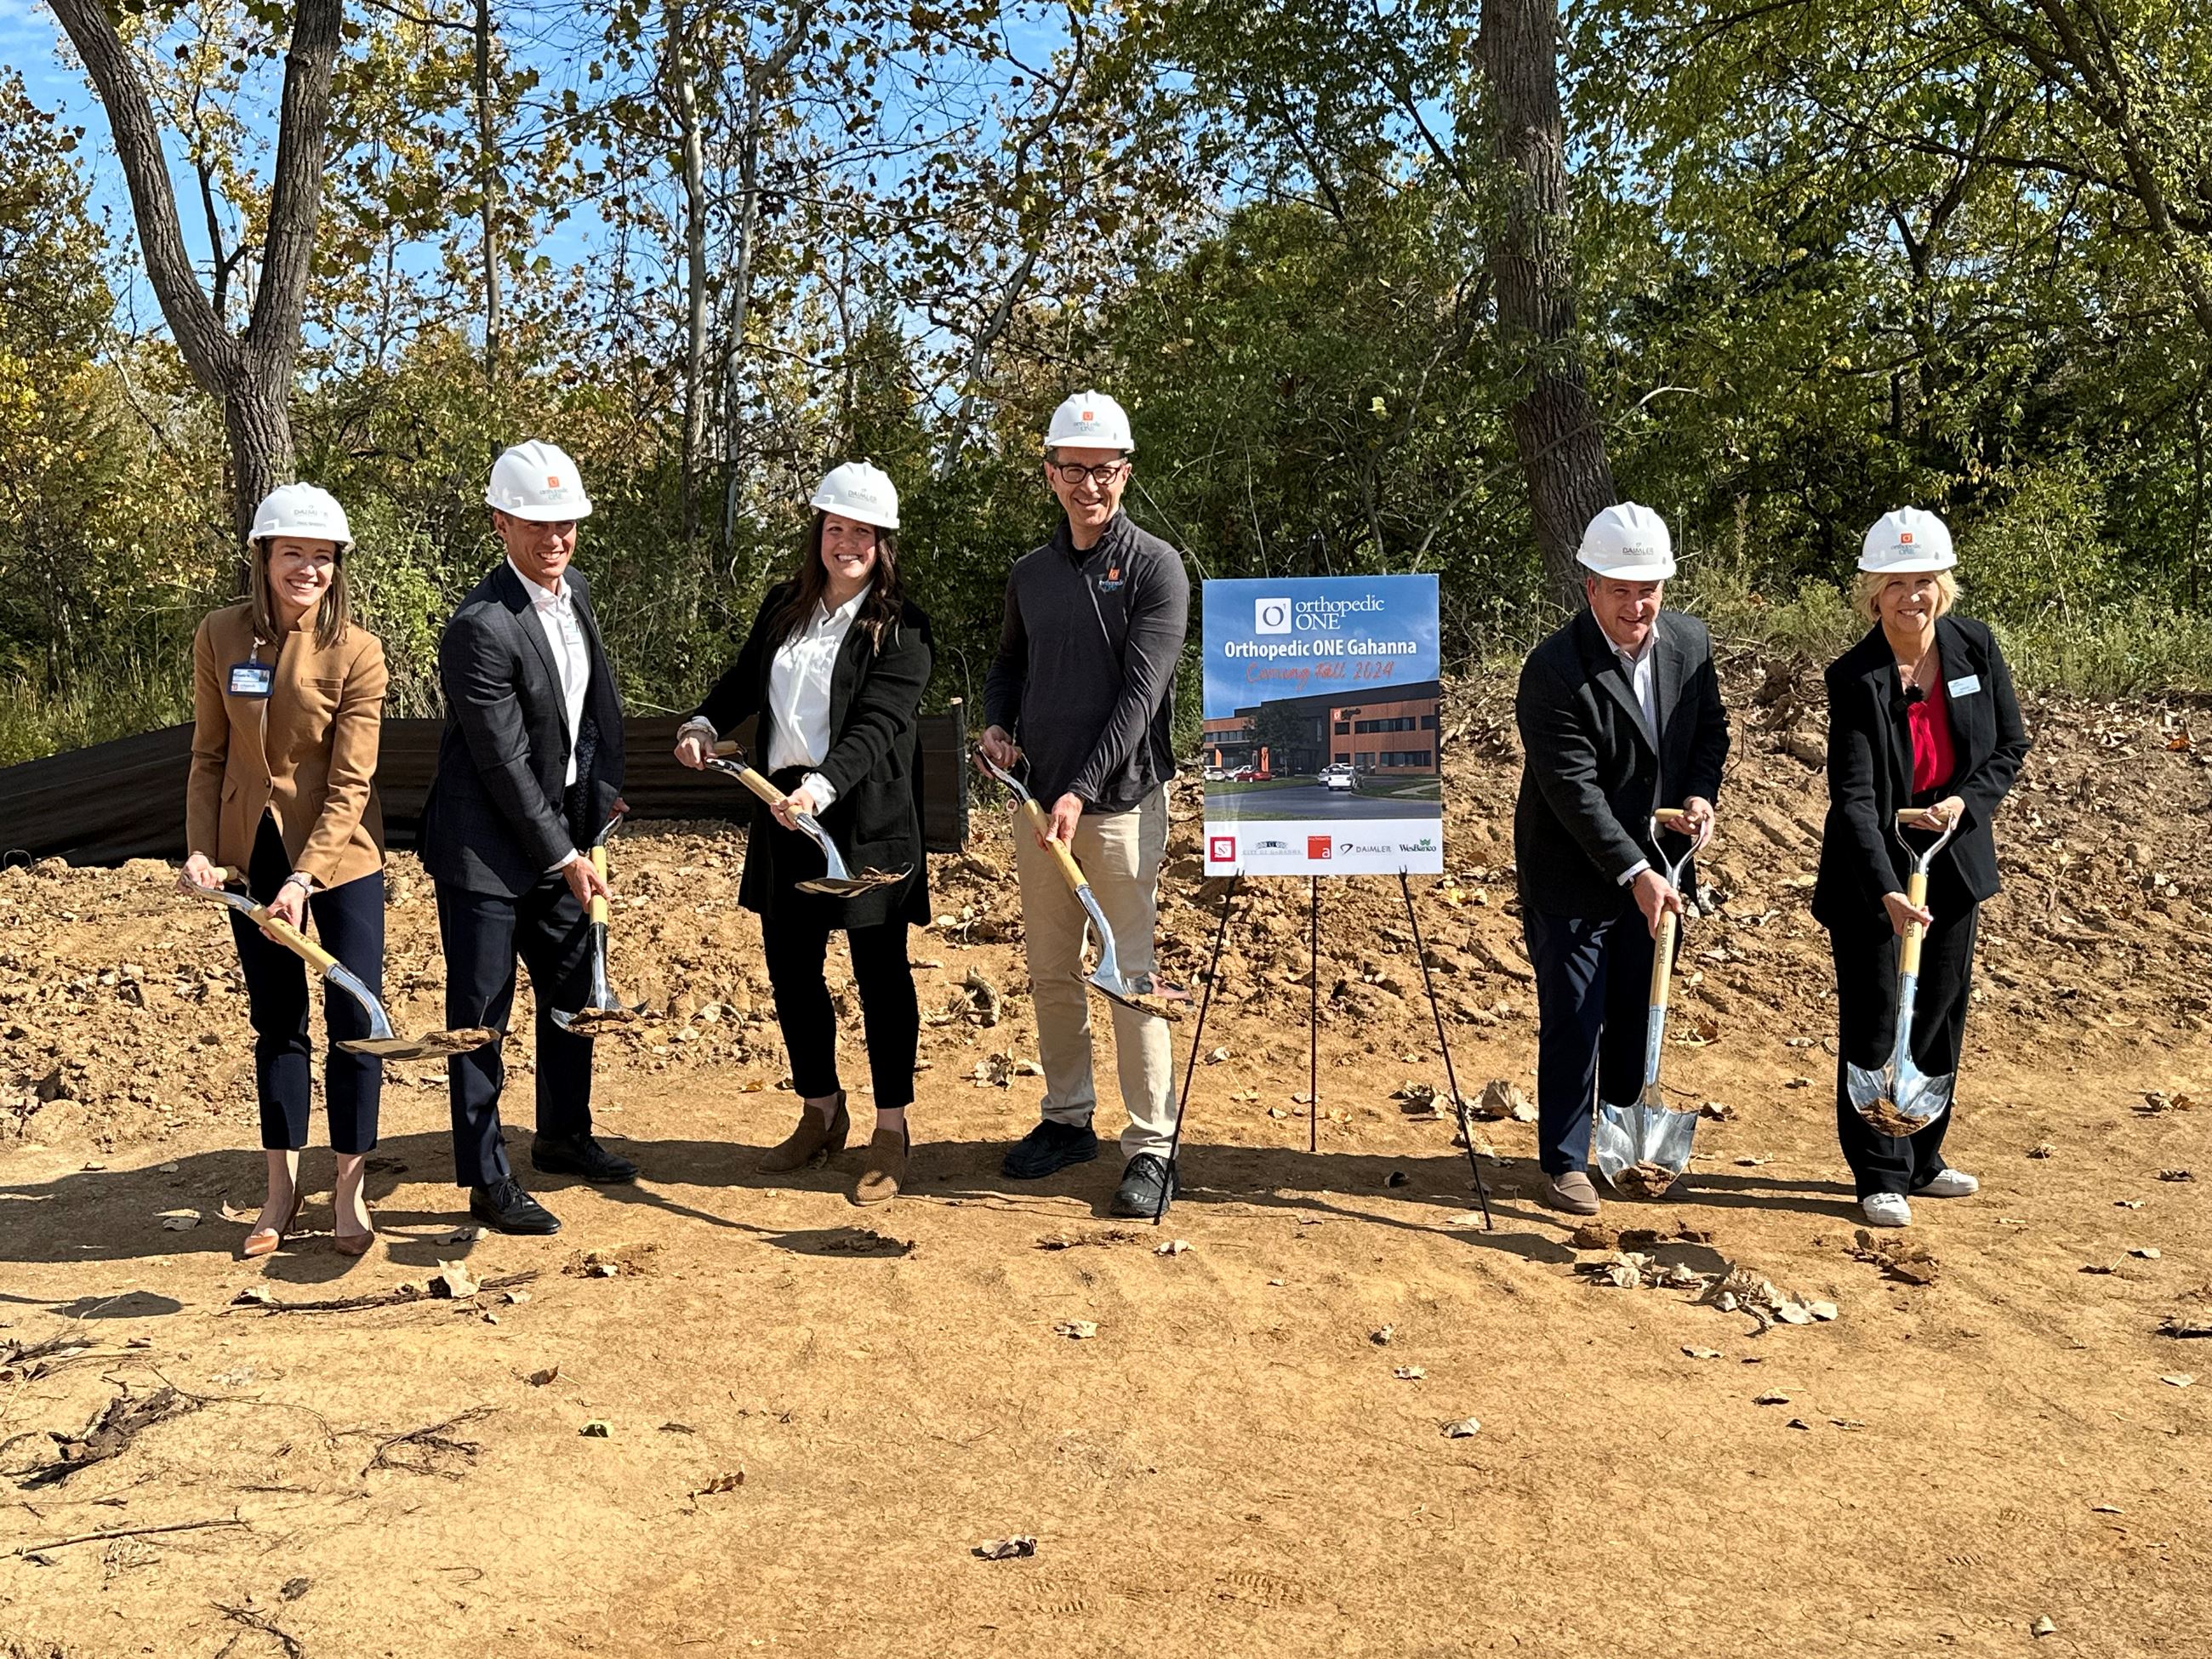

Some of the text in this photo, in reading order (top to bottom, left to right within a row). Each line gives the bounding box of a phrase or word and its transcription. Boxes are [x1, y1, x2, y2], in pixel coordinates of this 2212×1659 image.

[1296, 595, 1385, 618] orthopedic
[1296, 613, 1341, 630] ONE
[1224, 638, 1417, 660] Orthopedic ONE Gahanna
[1246, 661, 1310, 692] Coming
[1354, 660, 1395, 680] 2024
[1400, 844, 1437, 852] WesBanco
